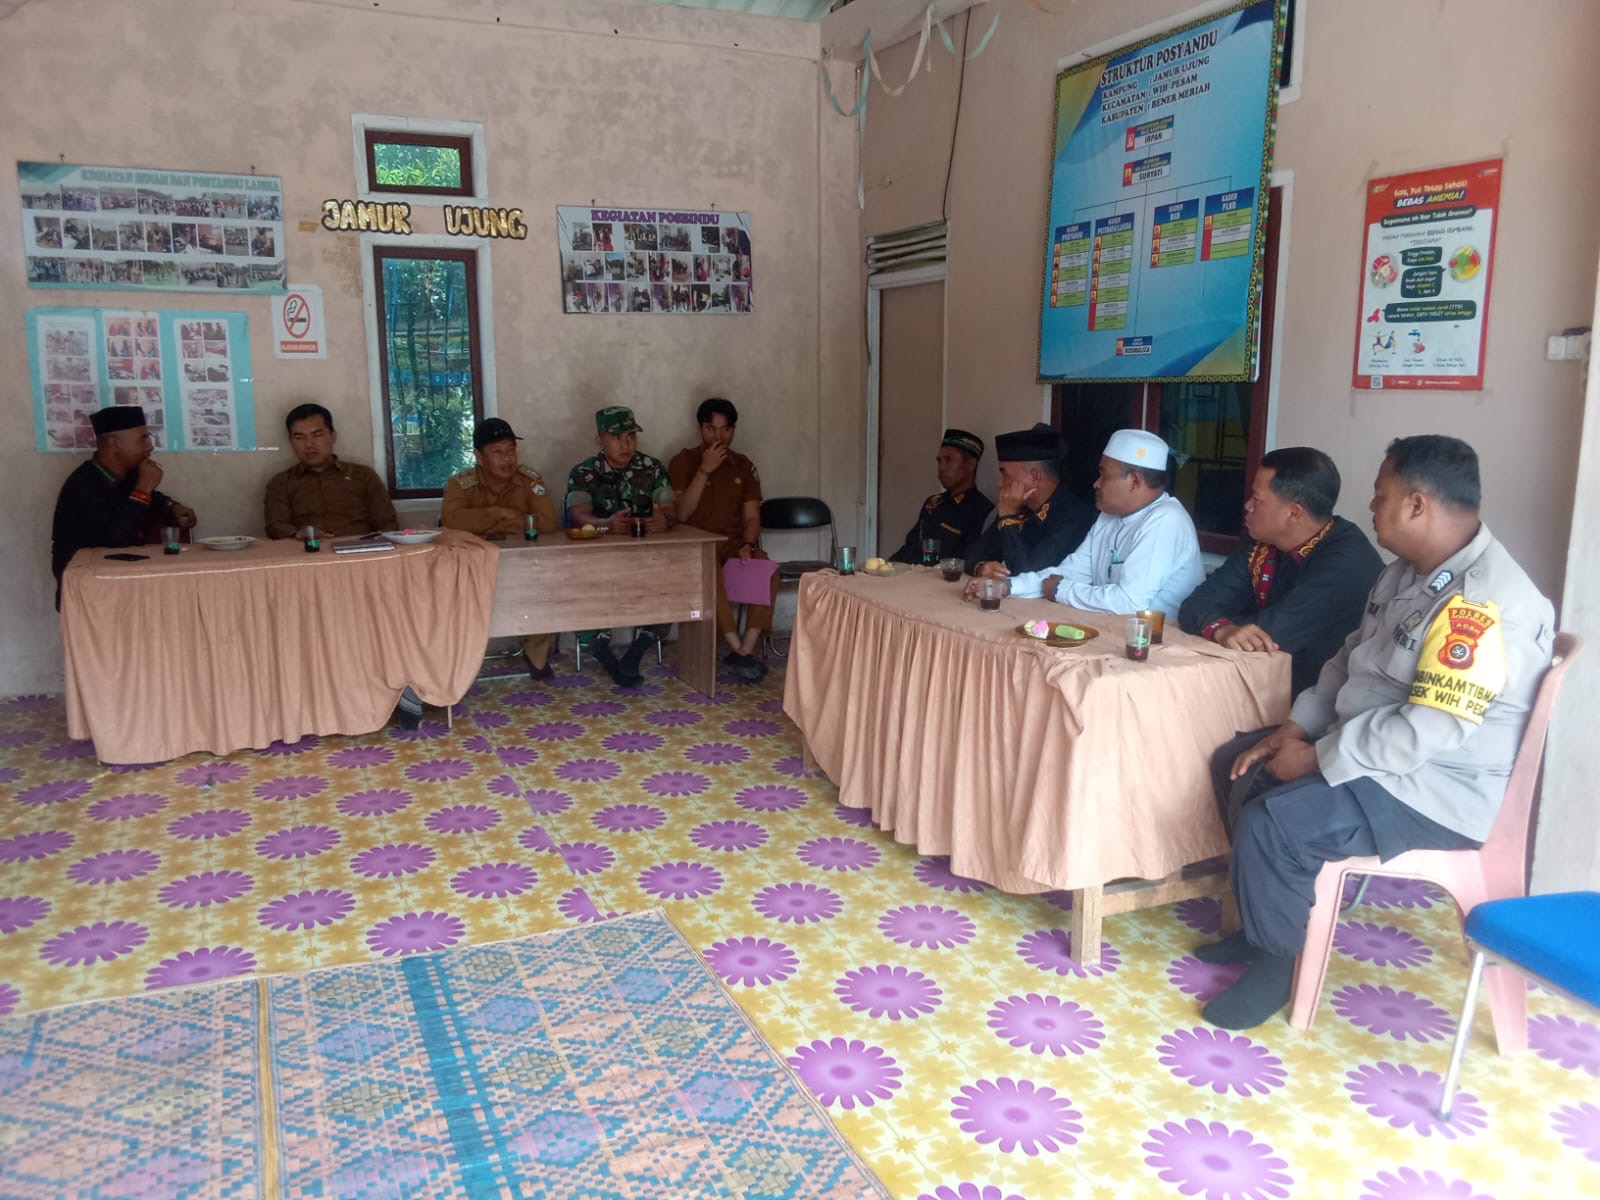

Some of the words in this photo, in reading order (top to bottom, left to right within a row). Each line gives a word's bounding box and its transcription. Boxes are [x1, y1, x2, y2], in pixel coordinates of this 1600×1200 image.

[1101, 56, 1153, 87] STRUKTUR
[1156, 30, 1218, 67] POSYANDU
[1103, 80, 1138, 99] KAMPUNG
[1153, 66, 1180, 83] JAMUR
[1181, 56, 1210, 73] UJUNG
[1101, 103, 1144, 125] KABUPATEN
[1151, 93, 1177, 109] BENER
[1178, 82, 1211, 100] MERIAH
[1102, 90, 1146, 112] KECAMATAN
[1171, 73, 1198, 90] PESAM
[591, 209, 657, 223] KEGIATAN
[658, 212, 720, 225] POSBINDU
[1396, 196, 1424, 208] BEBAS
[1426, 190, 1465, 203] ANEMIA!
[321, 199, 413, 235] JAMUR
[443, 205, 528, 240] UJUNG
[1452, 608, 1492, 626] POLRES
[1434, 689, 1461, 708] WIH
